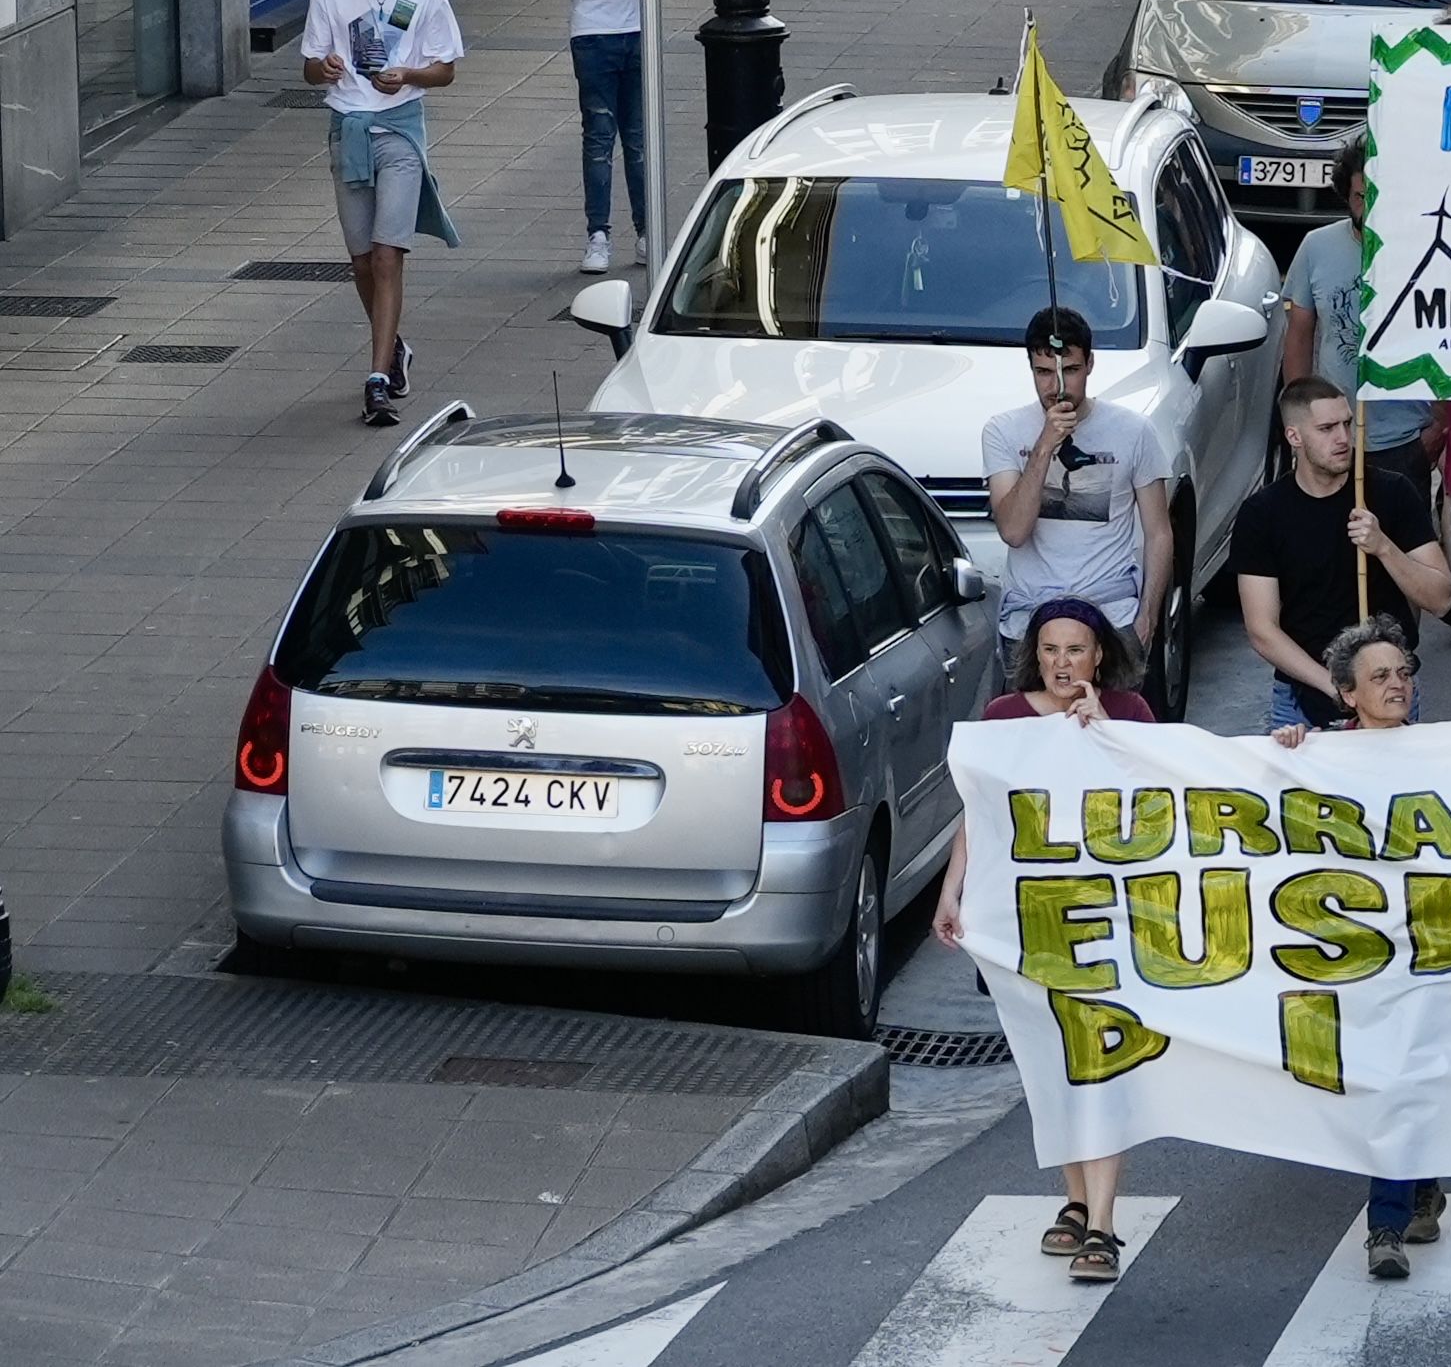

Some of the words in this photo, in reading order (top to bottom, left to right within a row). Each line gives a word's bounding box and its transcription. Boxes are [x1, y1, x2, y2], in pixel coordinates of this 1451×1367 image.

[1254, 161, 1306, 183] 3791
[447, 775, 532, 808] 7424
[547, 780, 611, 811] CKV
